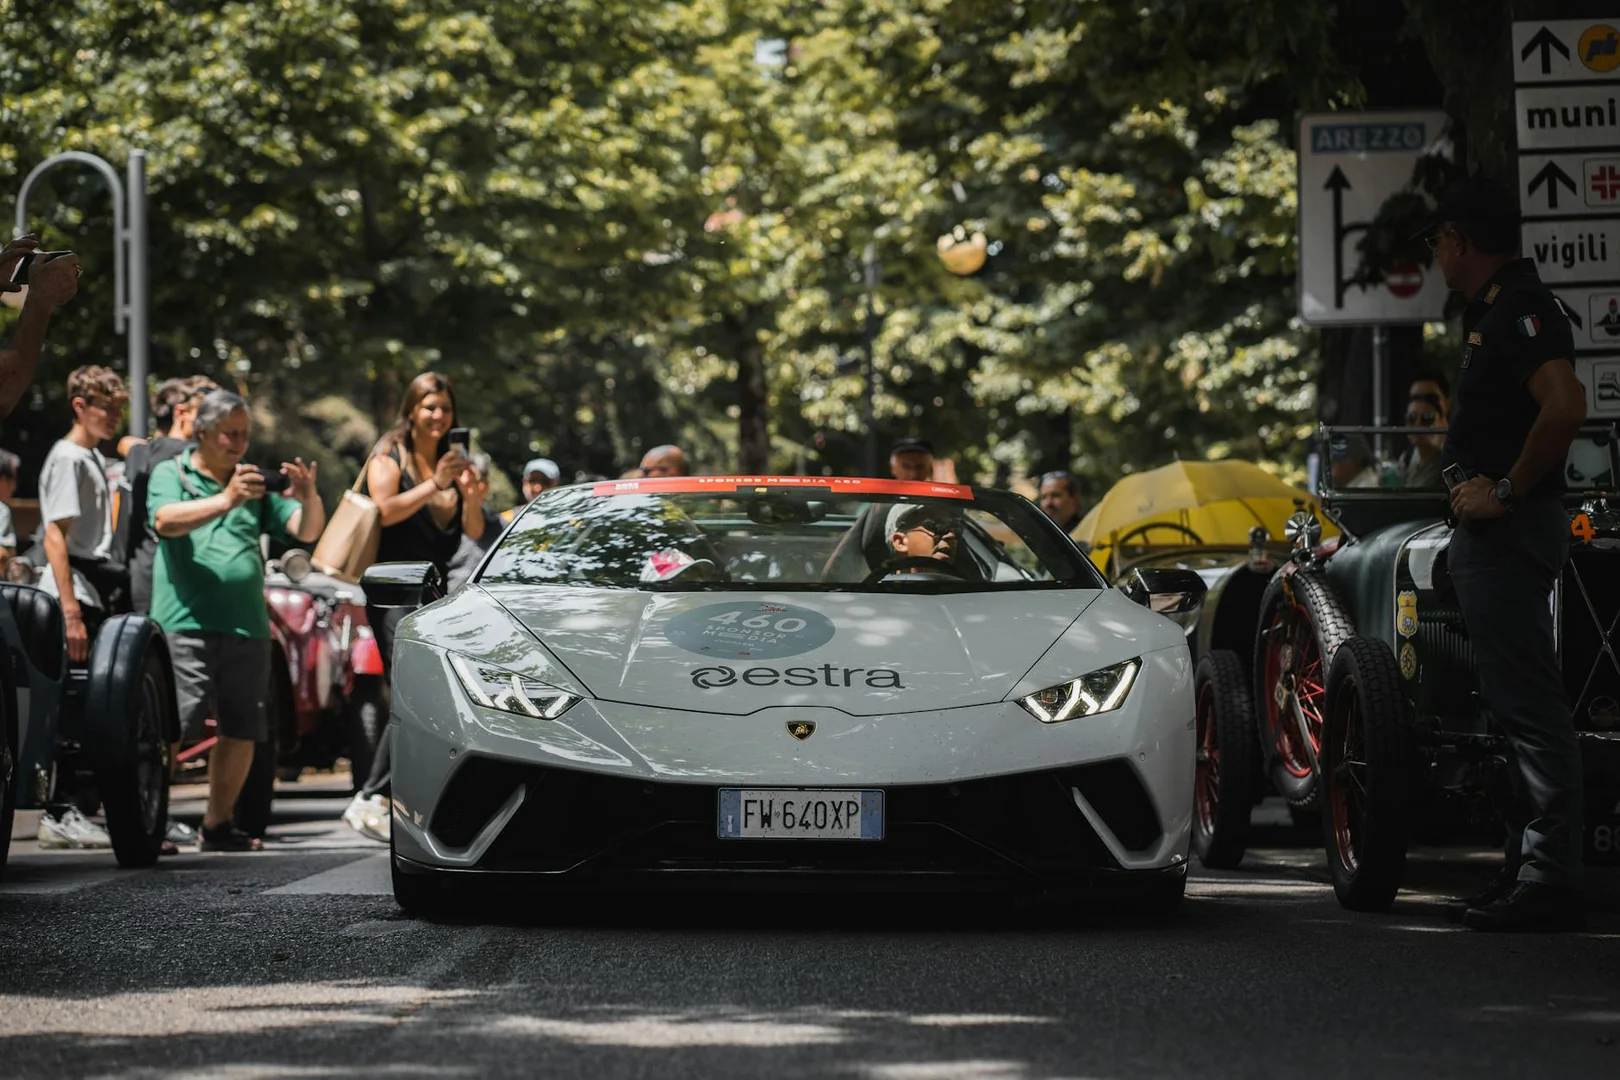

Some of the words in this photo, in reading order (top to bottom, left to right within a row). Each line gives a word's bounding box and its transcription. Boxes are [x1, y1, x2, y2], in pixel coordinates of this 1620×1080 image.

[1526, 97, 1617, 130] muni
[1314, 126, 1423, 149] AREZZO
[1533, 233, 1608, 269] vigili
[1570, 512, 1597, 544] 4
[704, 624, 788, 640] SPONSOR
[707, 611, 808, 633] 460
[742, 663, 906, 689] estra
